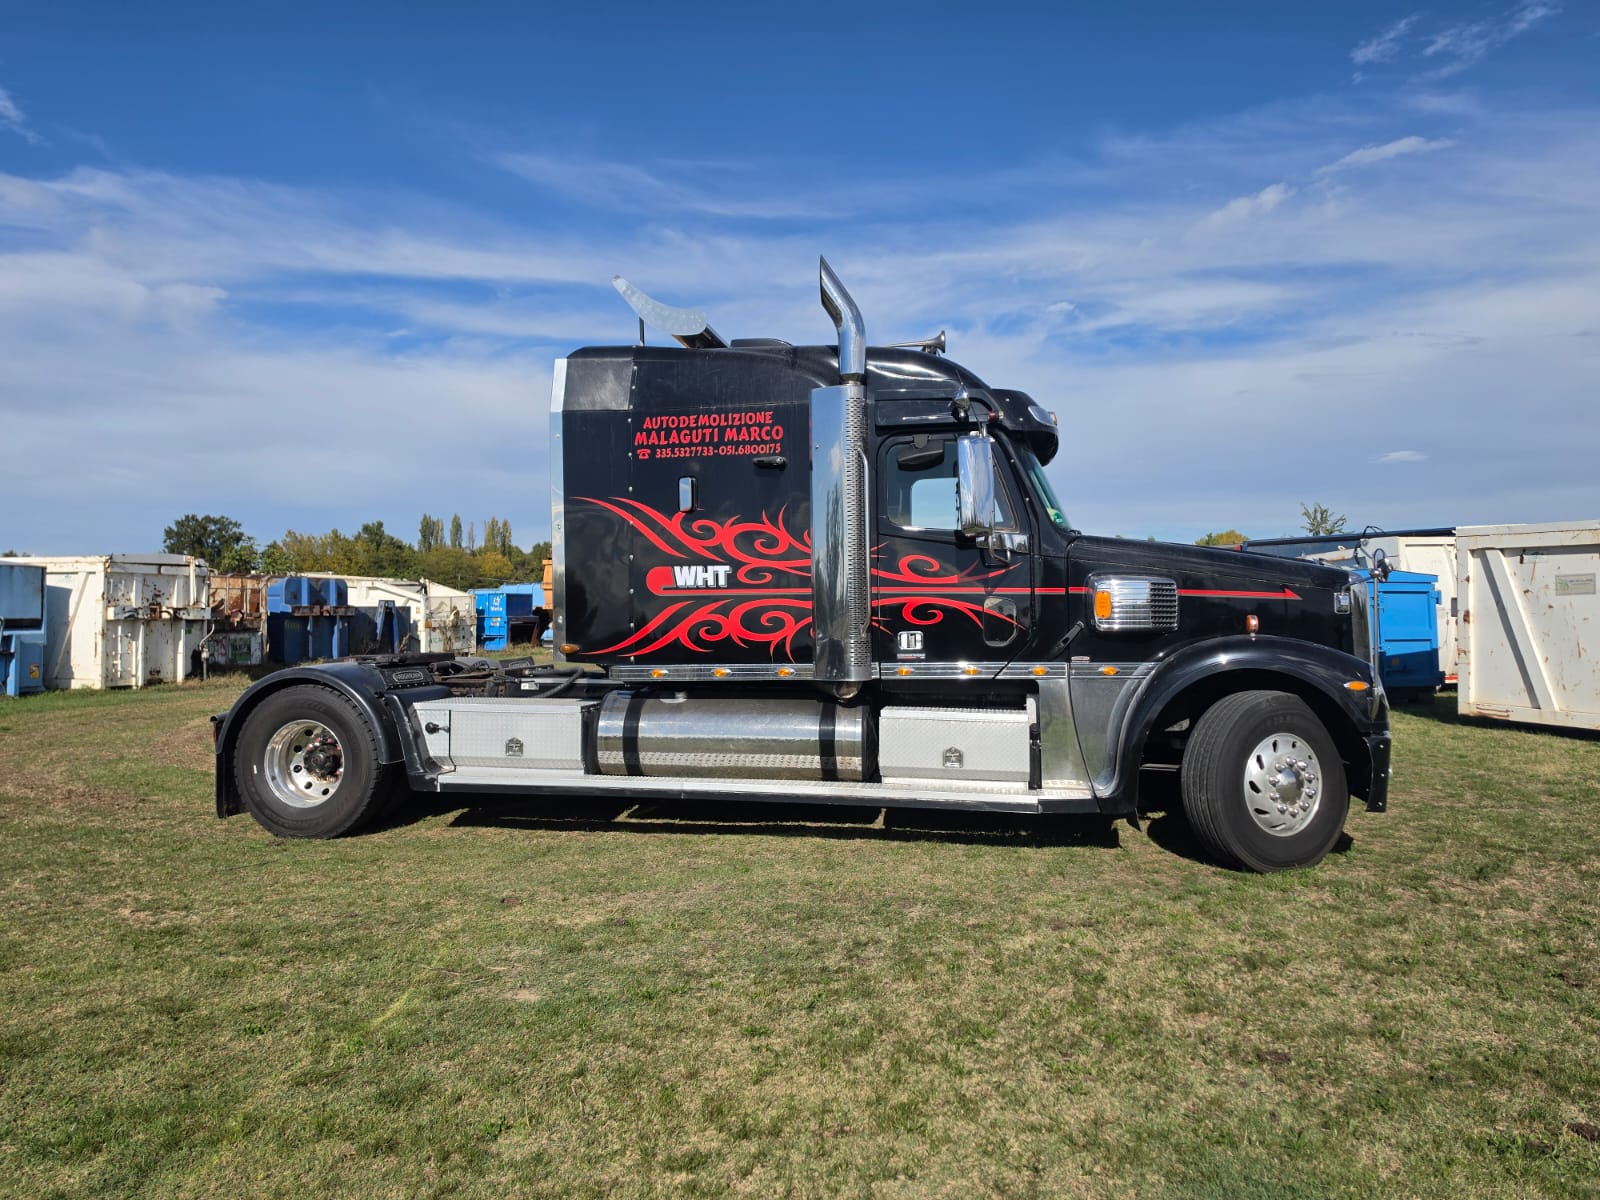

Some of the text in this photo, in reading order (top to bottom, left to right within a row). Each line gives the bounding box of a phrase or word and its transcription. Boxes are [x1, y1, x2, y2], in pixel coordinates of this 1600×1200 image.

[643, 411, 773, 430] AUTODEMOLIZIONE
[634, 425, 784, 446] MALAGUTI MARCO
[674, 565, 732, 588] WHT
